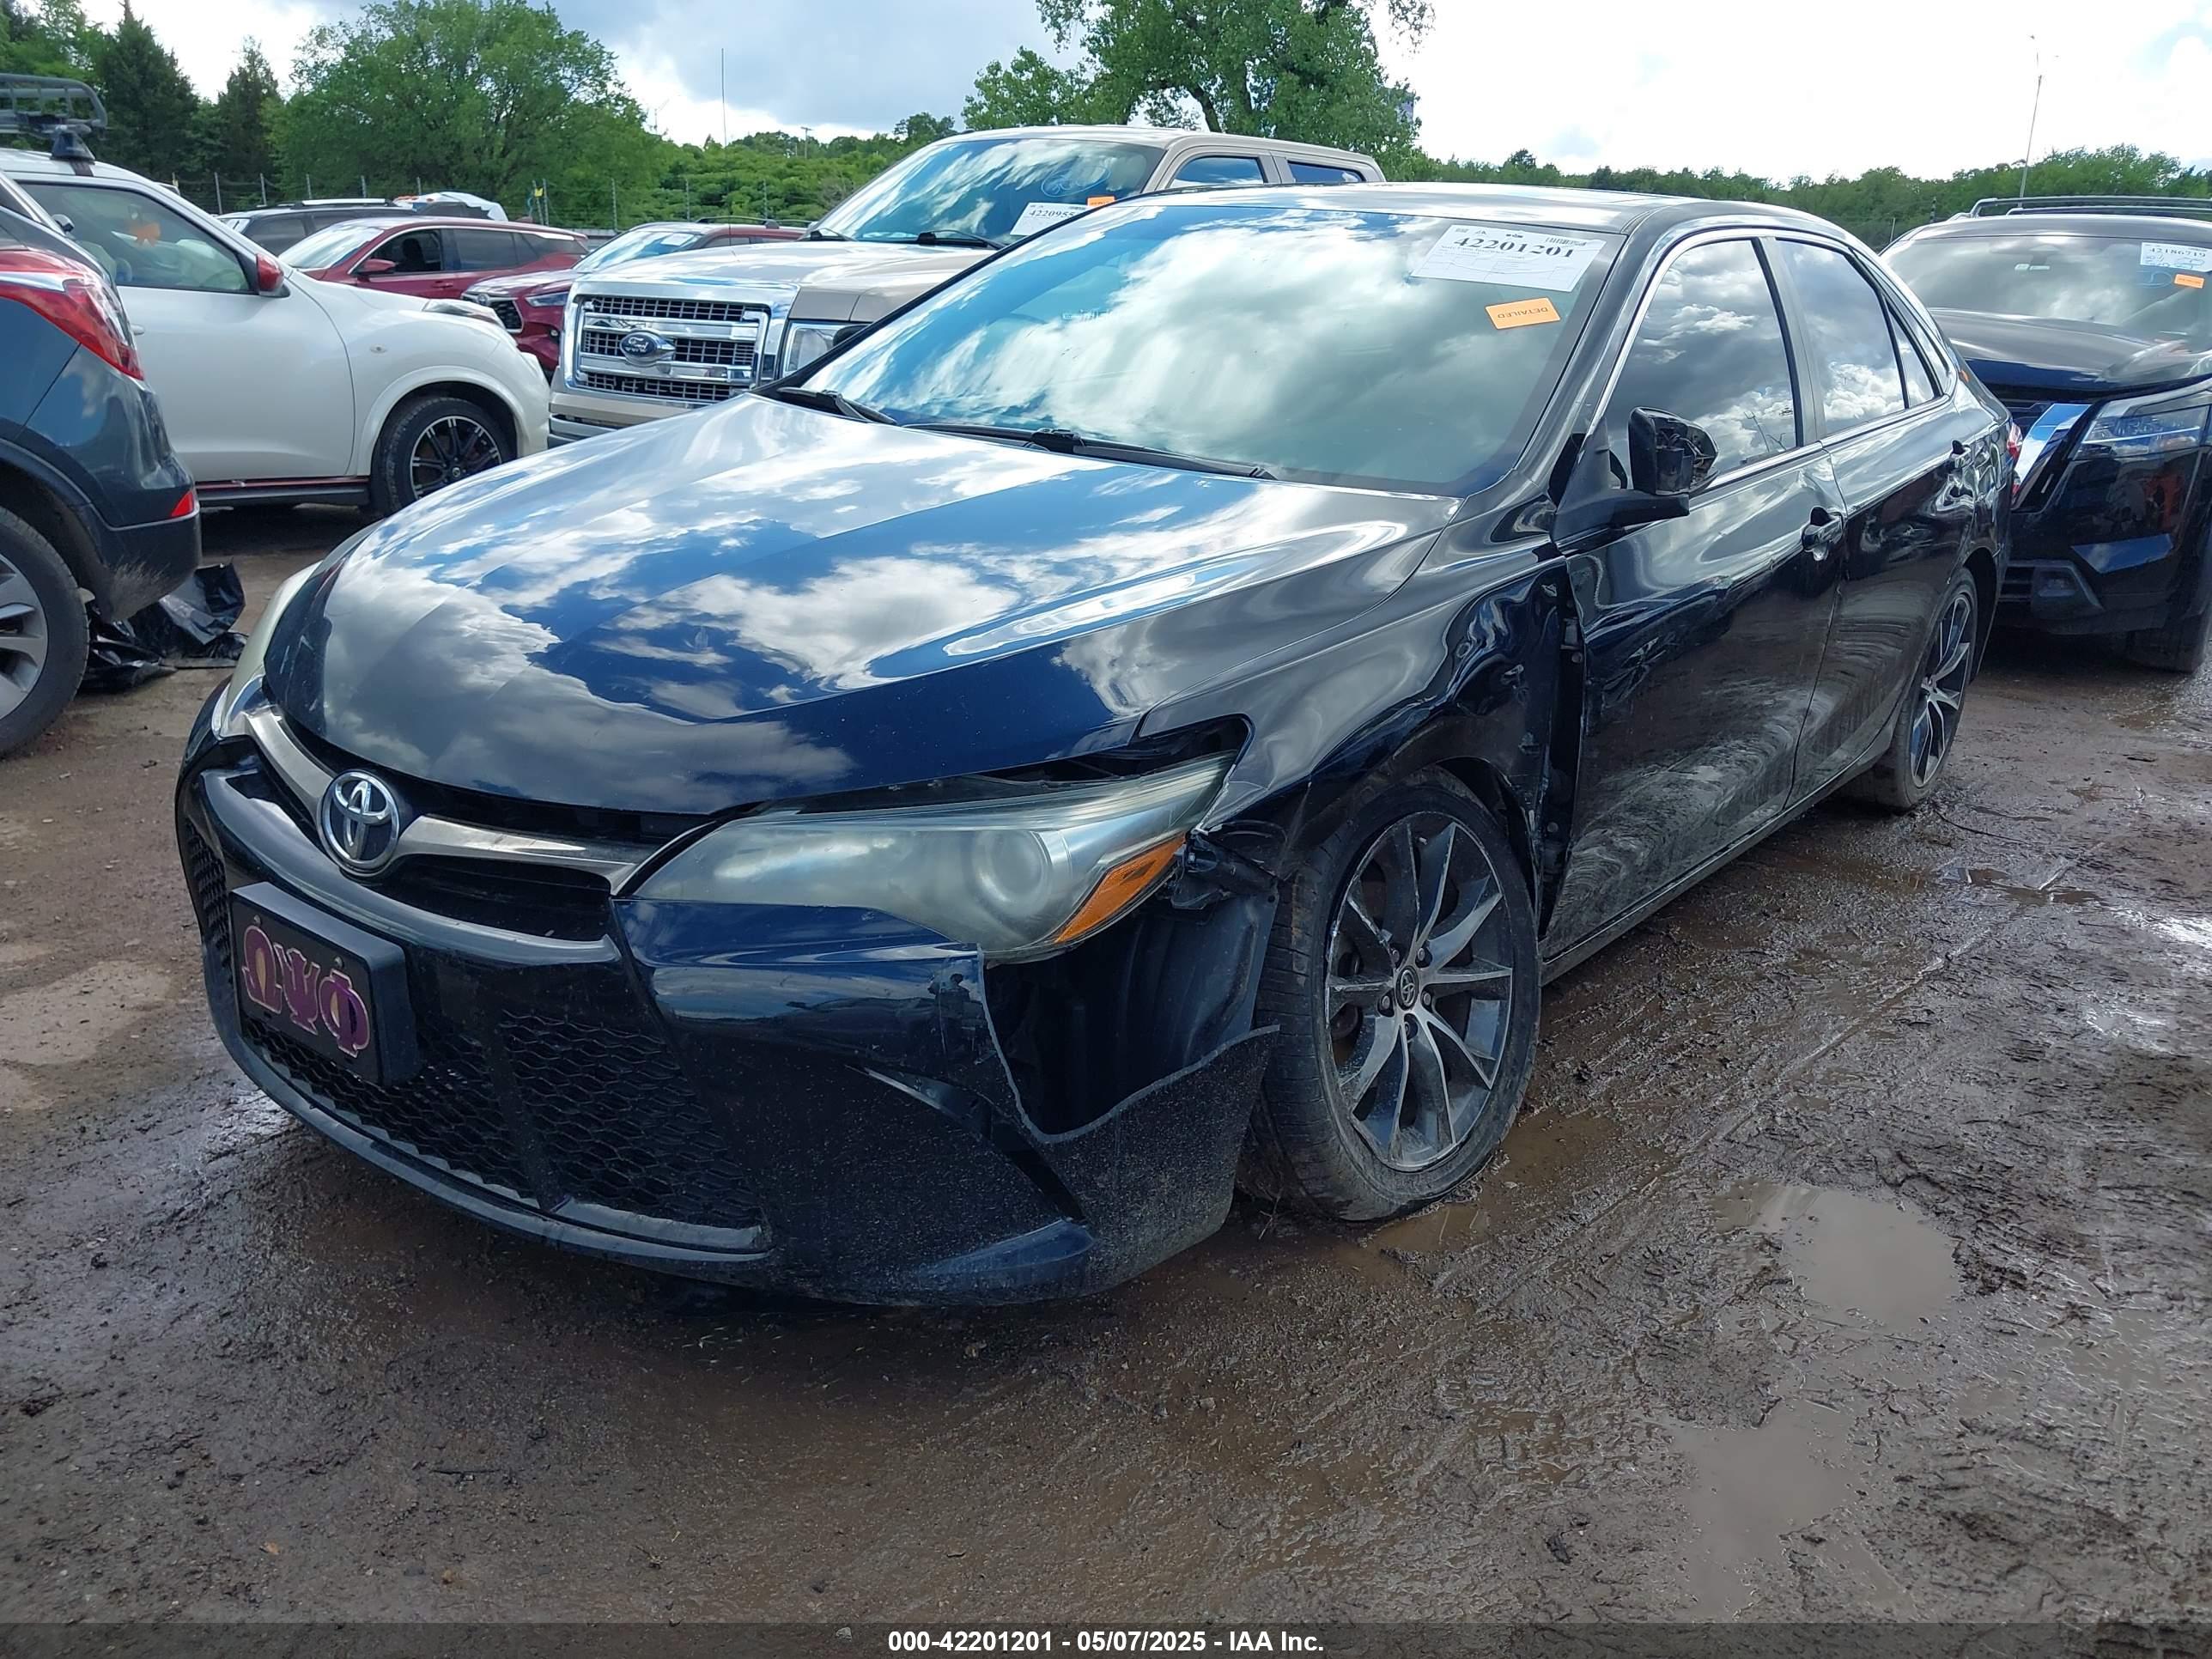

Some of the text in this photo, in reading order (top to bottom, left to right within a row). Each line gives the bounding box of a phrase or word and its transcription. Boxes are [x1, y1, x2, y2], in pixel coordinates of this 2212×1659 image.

[1029, 209, 1076, 218] 4220955
[1454, 237, 1574, 258] 42201201
[1498, 307, 1548, 319] DETAILED
[625, 337, 649, 353] Ford
